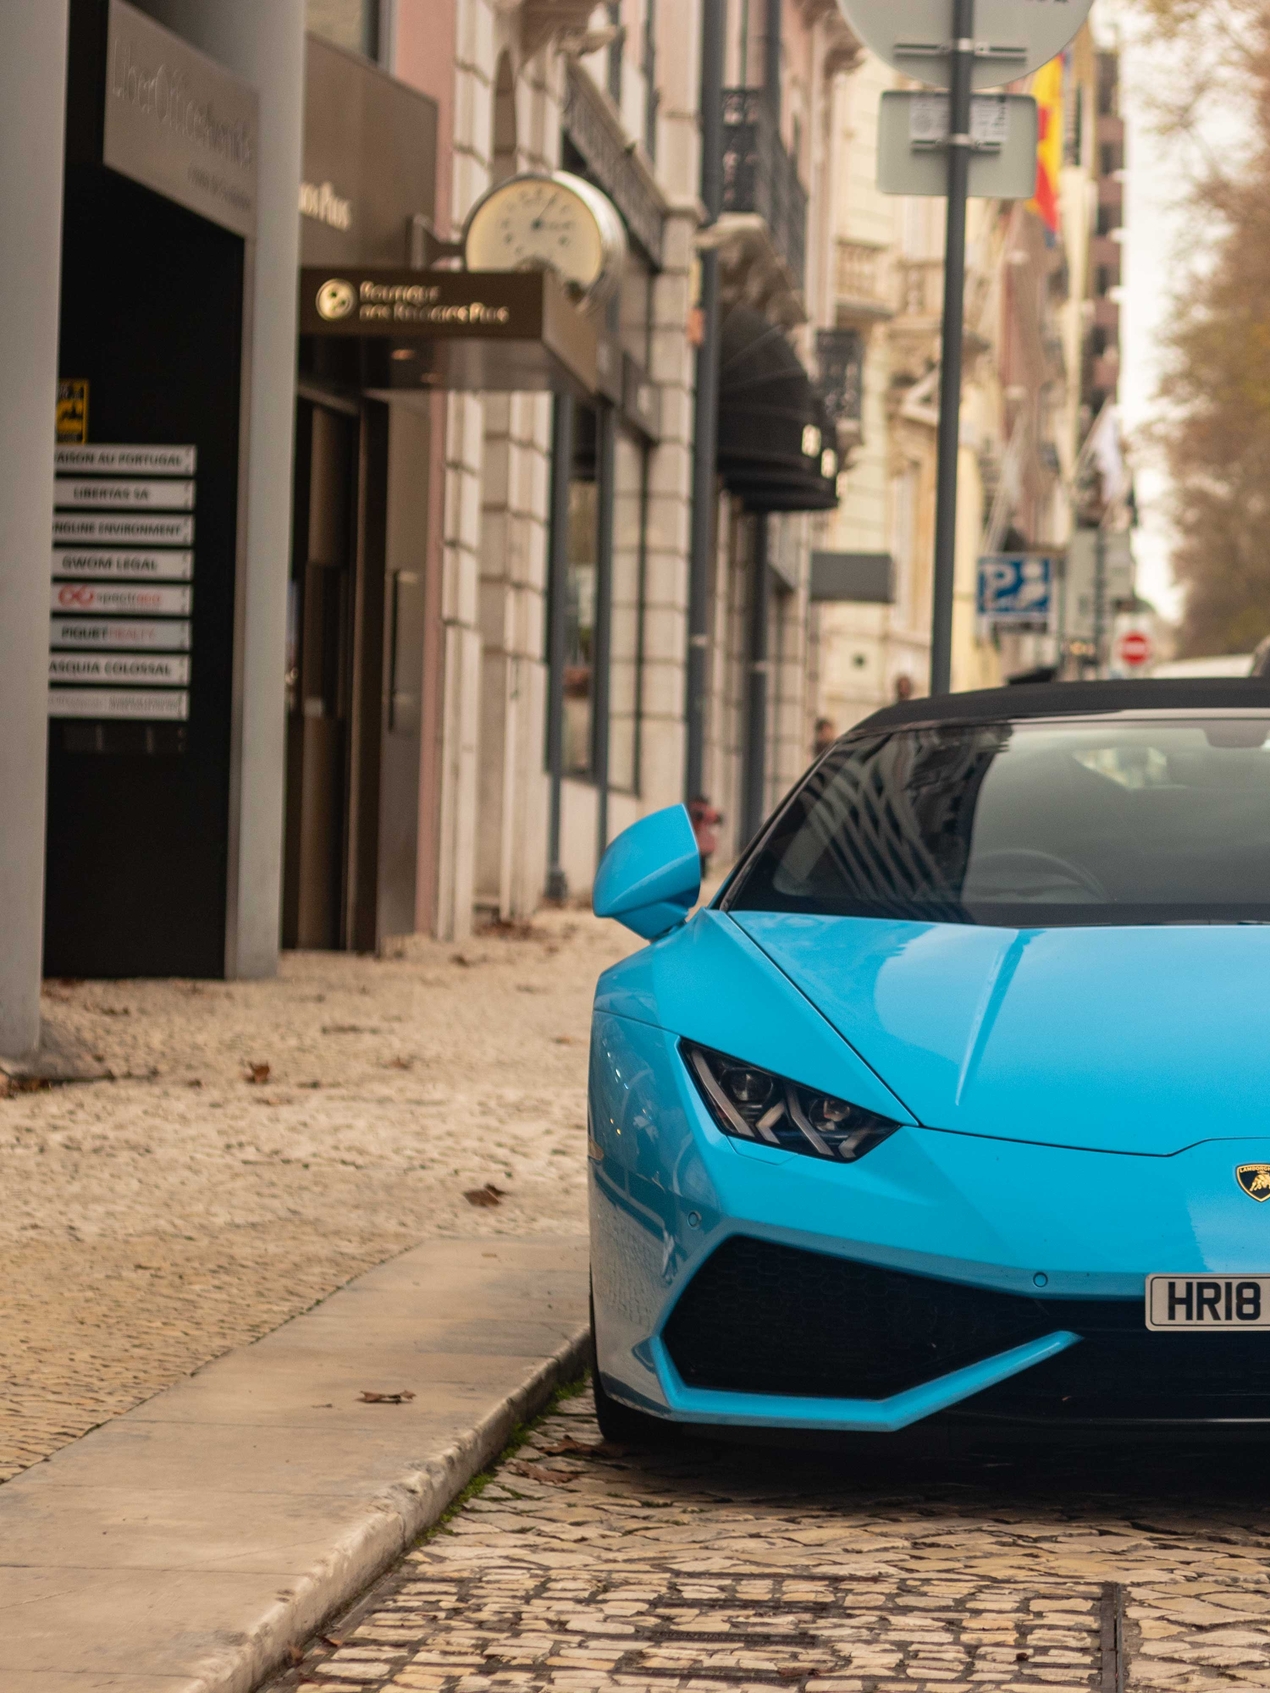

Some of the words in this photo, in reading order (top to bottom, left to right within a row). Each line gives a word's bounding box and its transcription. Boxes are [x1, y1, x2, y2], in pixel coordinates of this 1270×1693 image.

[118, 453, 182, 466] PORTUGAL
[98, 522, 182, 535] ENVIRONMENT
[116, 557, 158, 571] LEGAL
[104, 661, 171, 675] COLOSSAL
[1168, 1281, 1261, 1321] HR18
